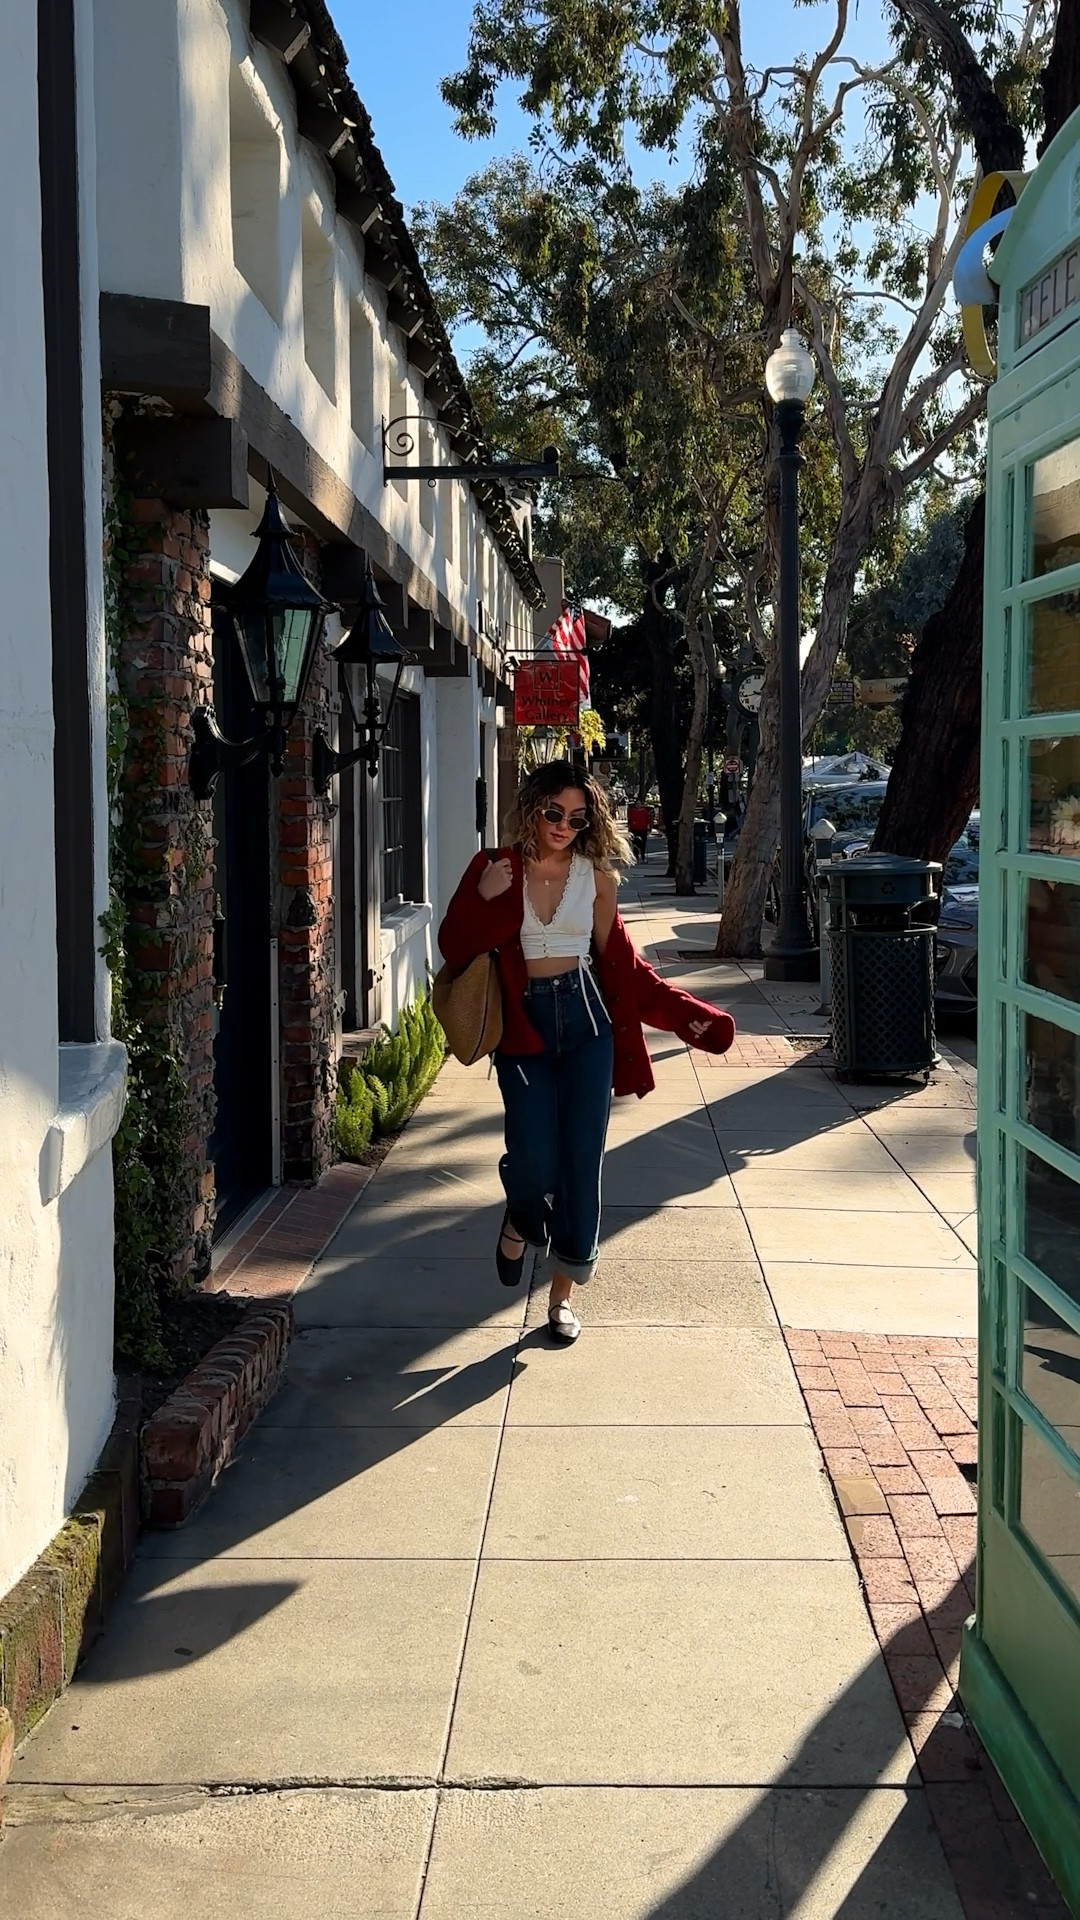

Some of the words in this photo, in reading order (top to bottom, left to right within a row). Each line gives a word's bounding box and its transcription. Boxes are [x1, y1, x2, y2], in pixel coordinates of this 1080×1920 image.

[1026, 251, 1078, 337] TELE
[538, 671, 553, 682] W
[525, 709, 568, 722] Gallery
